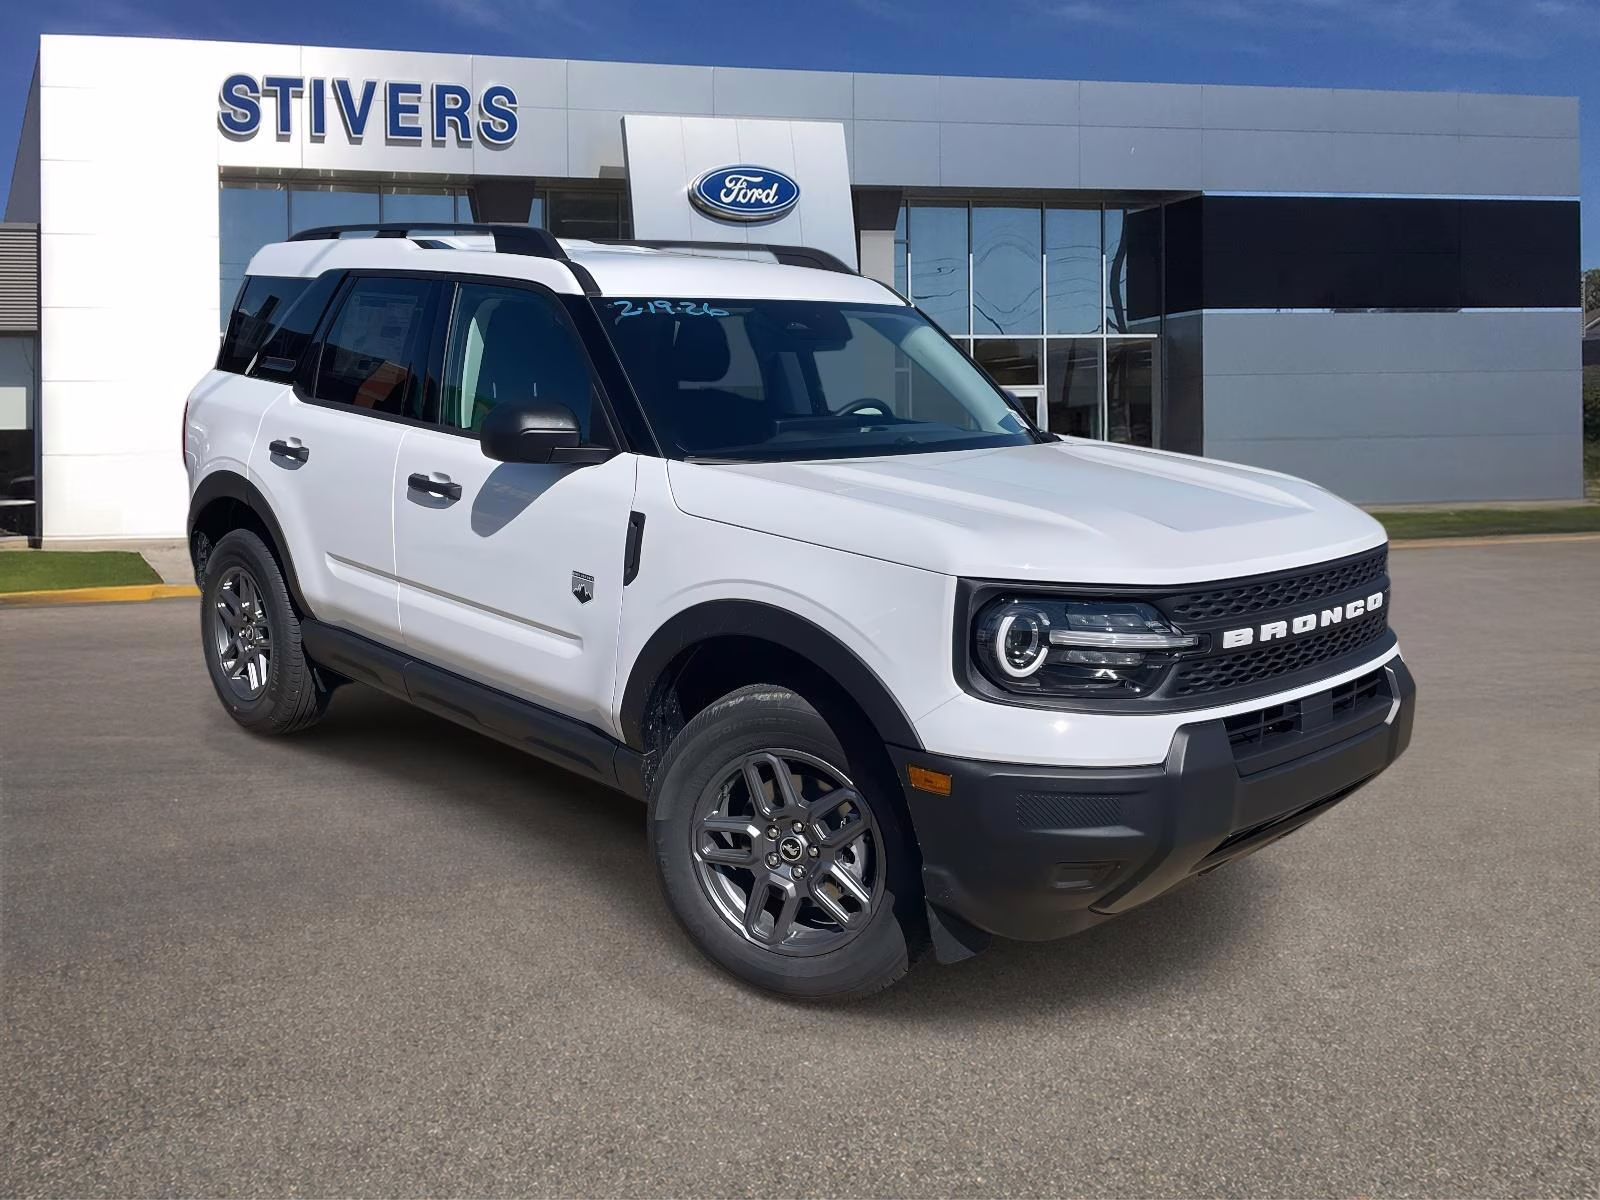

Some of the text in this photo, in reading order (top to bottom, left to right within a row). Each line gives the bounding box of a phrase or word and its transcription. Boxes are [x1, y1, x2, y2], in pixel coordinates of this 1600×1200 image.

[218, 73, 518, 145] STIVERS
[720, 174, 778, 204] Ford
[1222, 591, 1384, 649] BRONCO
